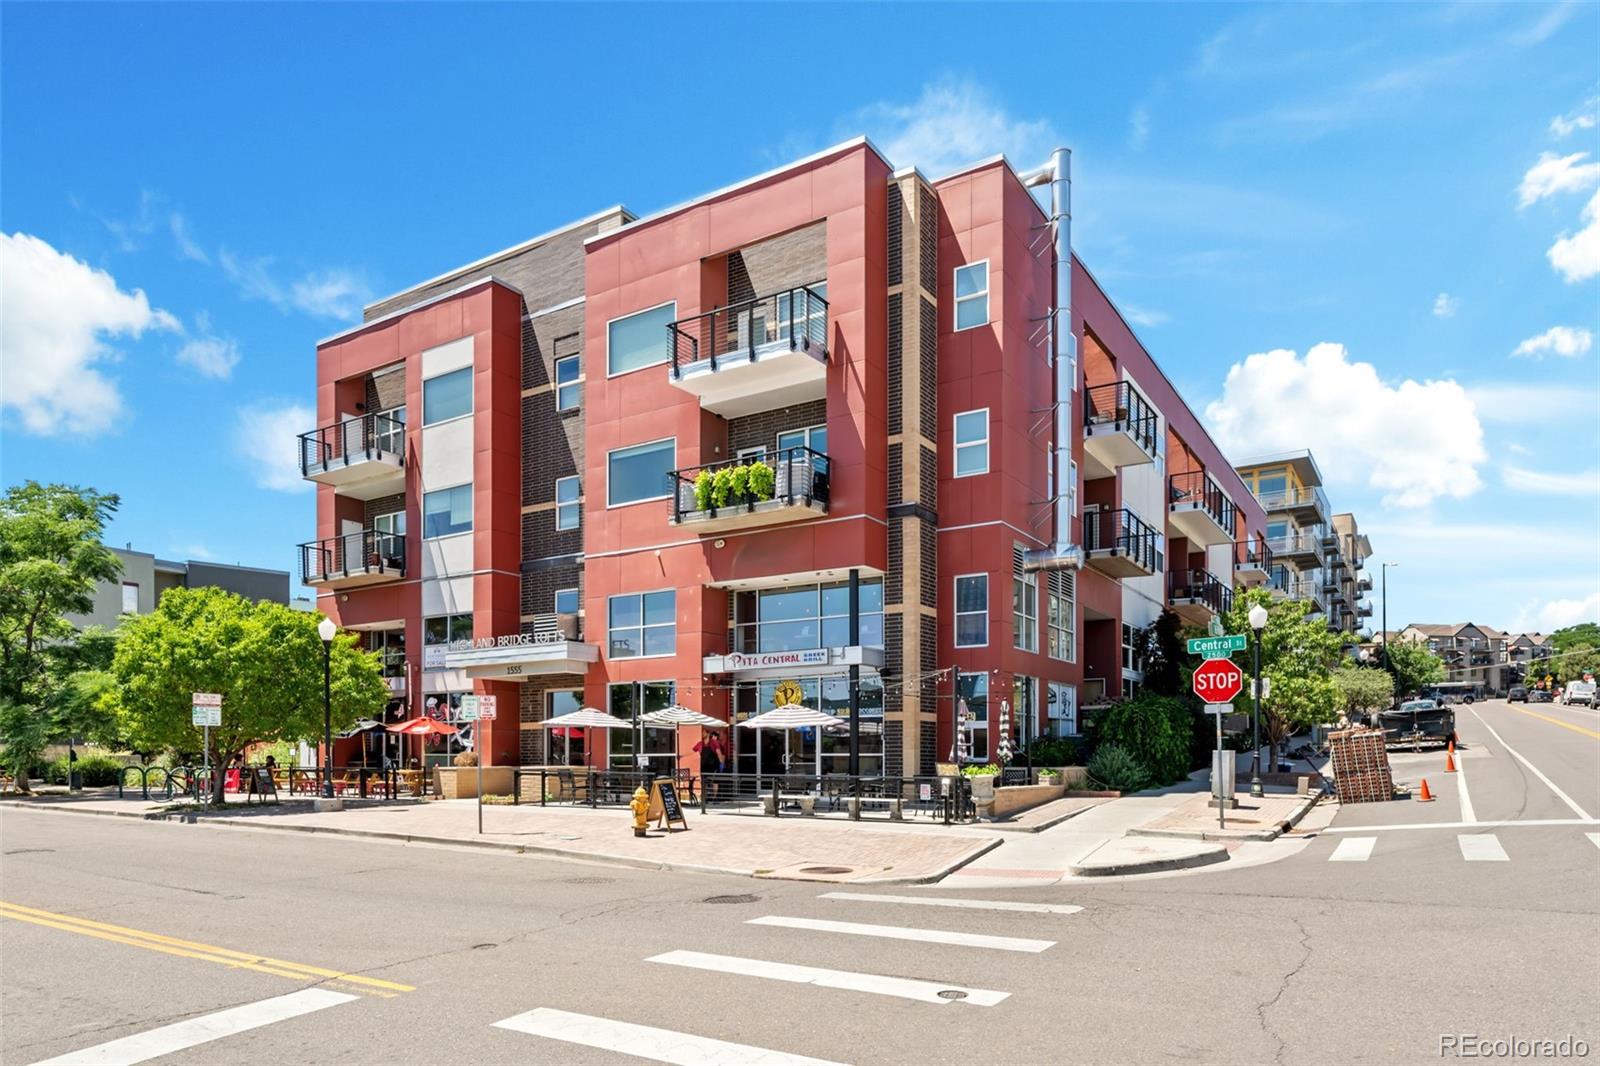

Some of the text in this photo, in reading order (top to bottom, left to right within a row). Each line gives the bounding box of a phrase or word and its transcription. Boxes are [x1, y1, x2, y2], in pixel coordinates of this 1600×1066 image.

[497, 633, 532, 647] BRIDGE
[534, 630, 565, 644] LOFTS
[1194, 639, 1231, 651] Central
[730, 654, 800, 668] PITA CENTRAL
[506, 665, 522, 675] 1555
[1197, 672, 1238, 690] STOP
